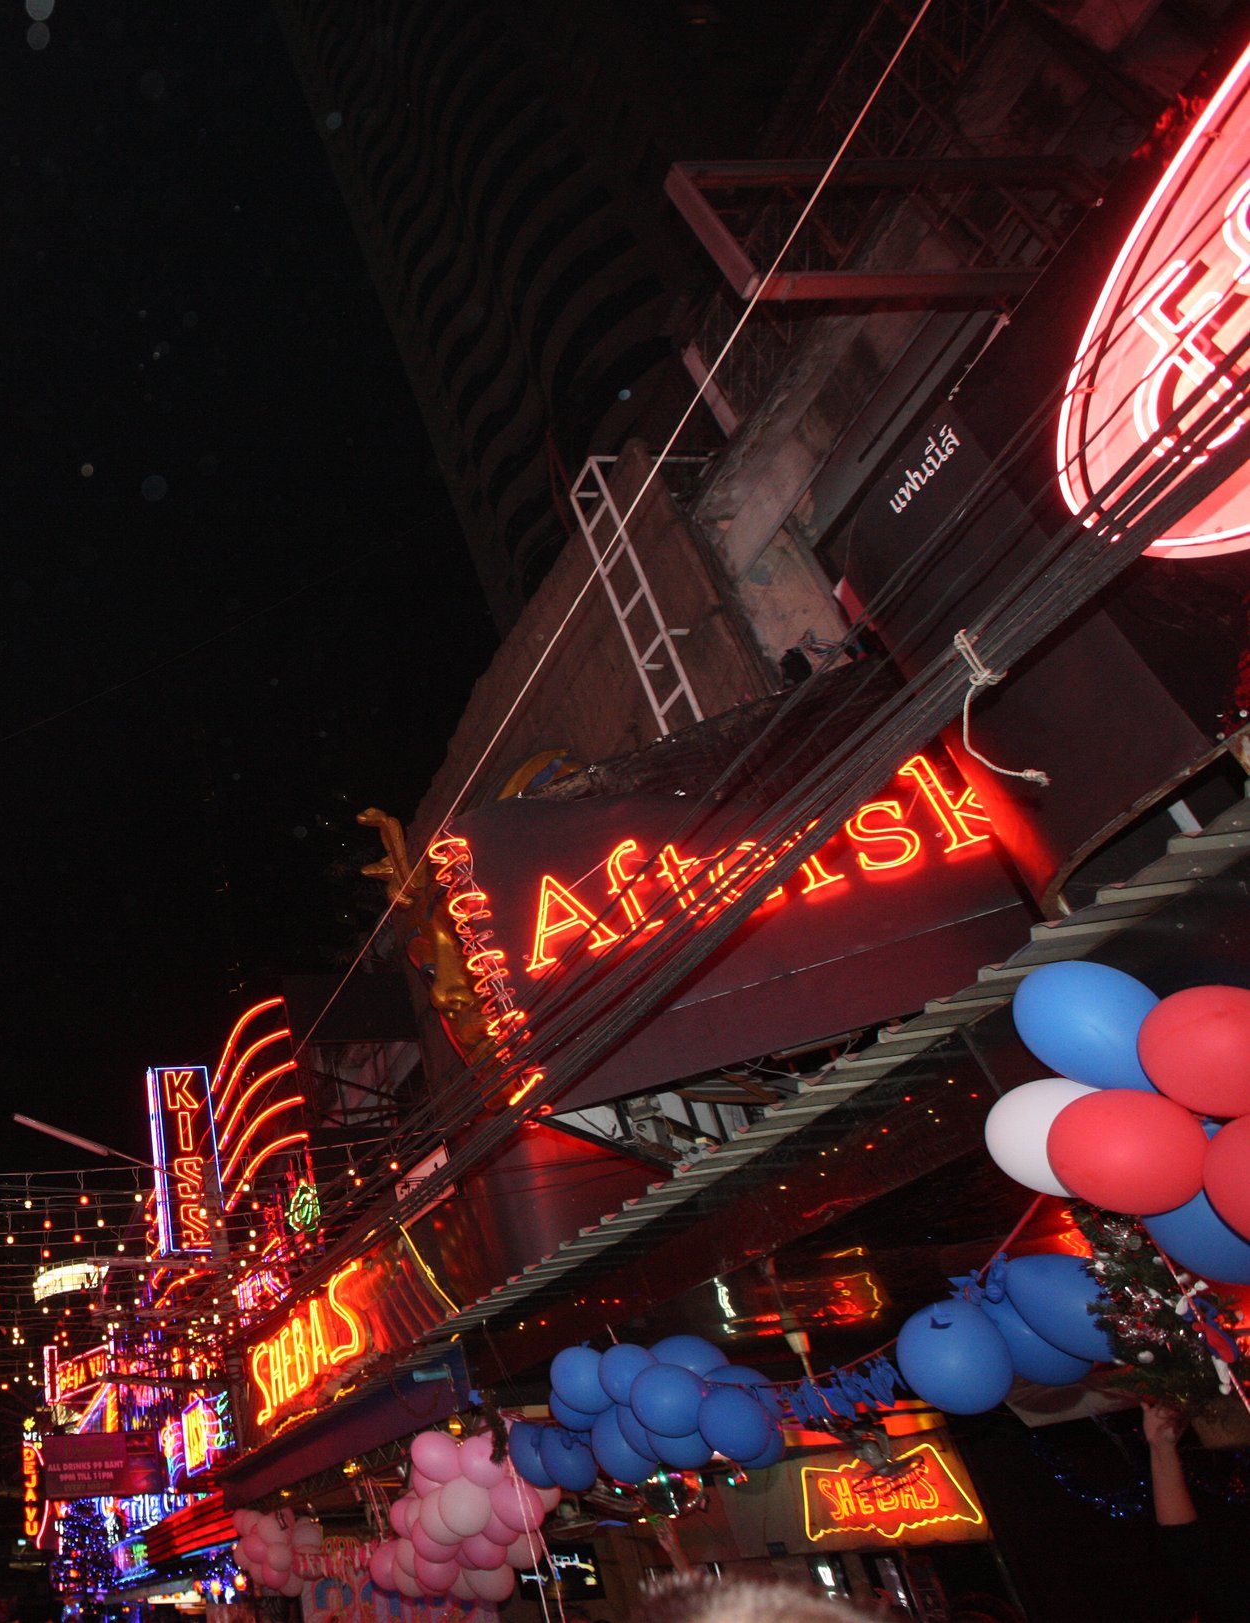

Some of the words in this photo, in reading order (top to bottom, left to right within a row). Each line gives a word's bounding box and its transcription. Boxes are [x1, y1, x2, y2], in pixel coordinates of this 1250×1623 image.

[164, 1071, 212, 1247] KISS
[23, 1448, 39, 1502] DEJA
[47, 1463, 61, 1473] ALL
[63, 1462, 91, 1471] DRINKS
[77, 1472, 92, 1481] TILL
[24, 1506, 39, 1537] VU
